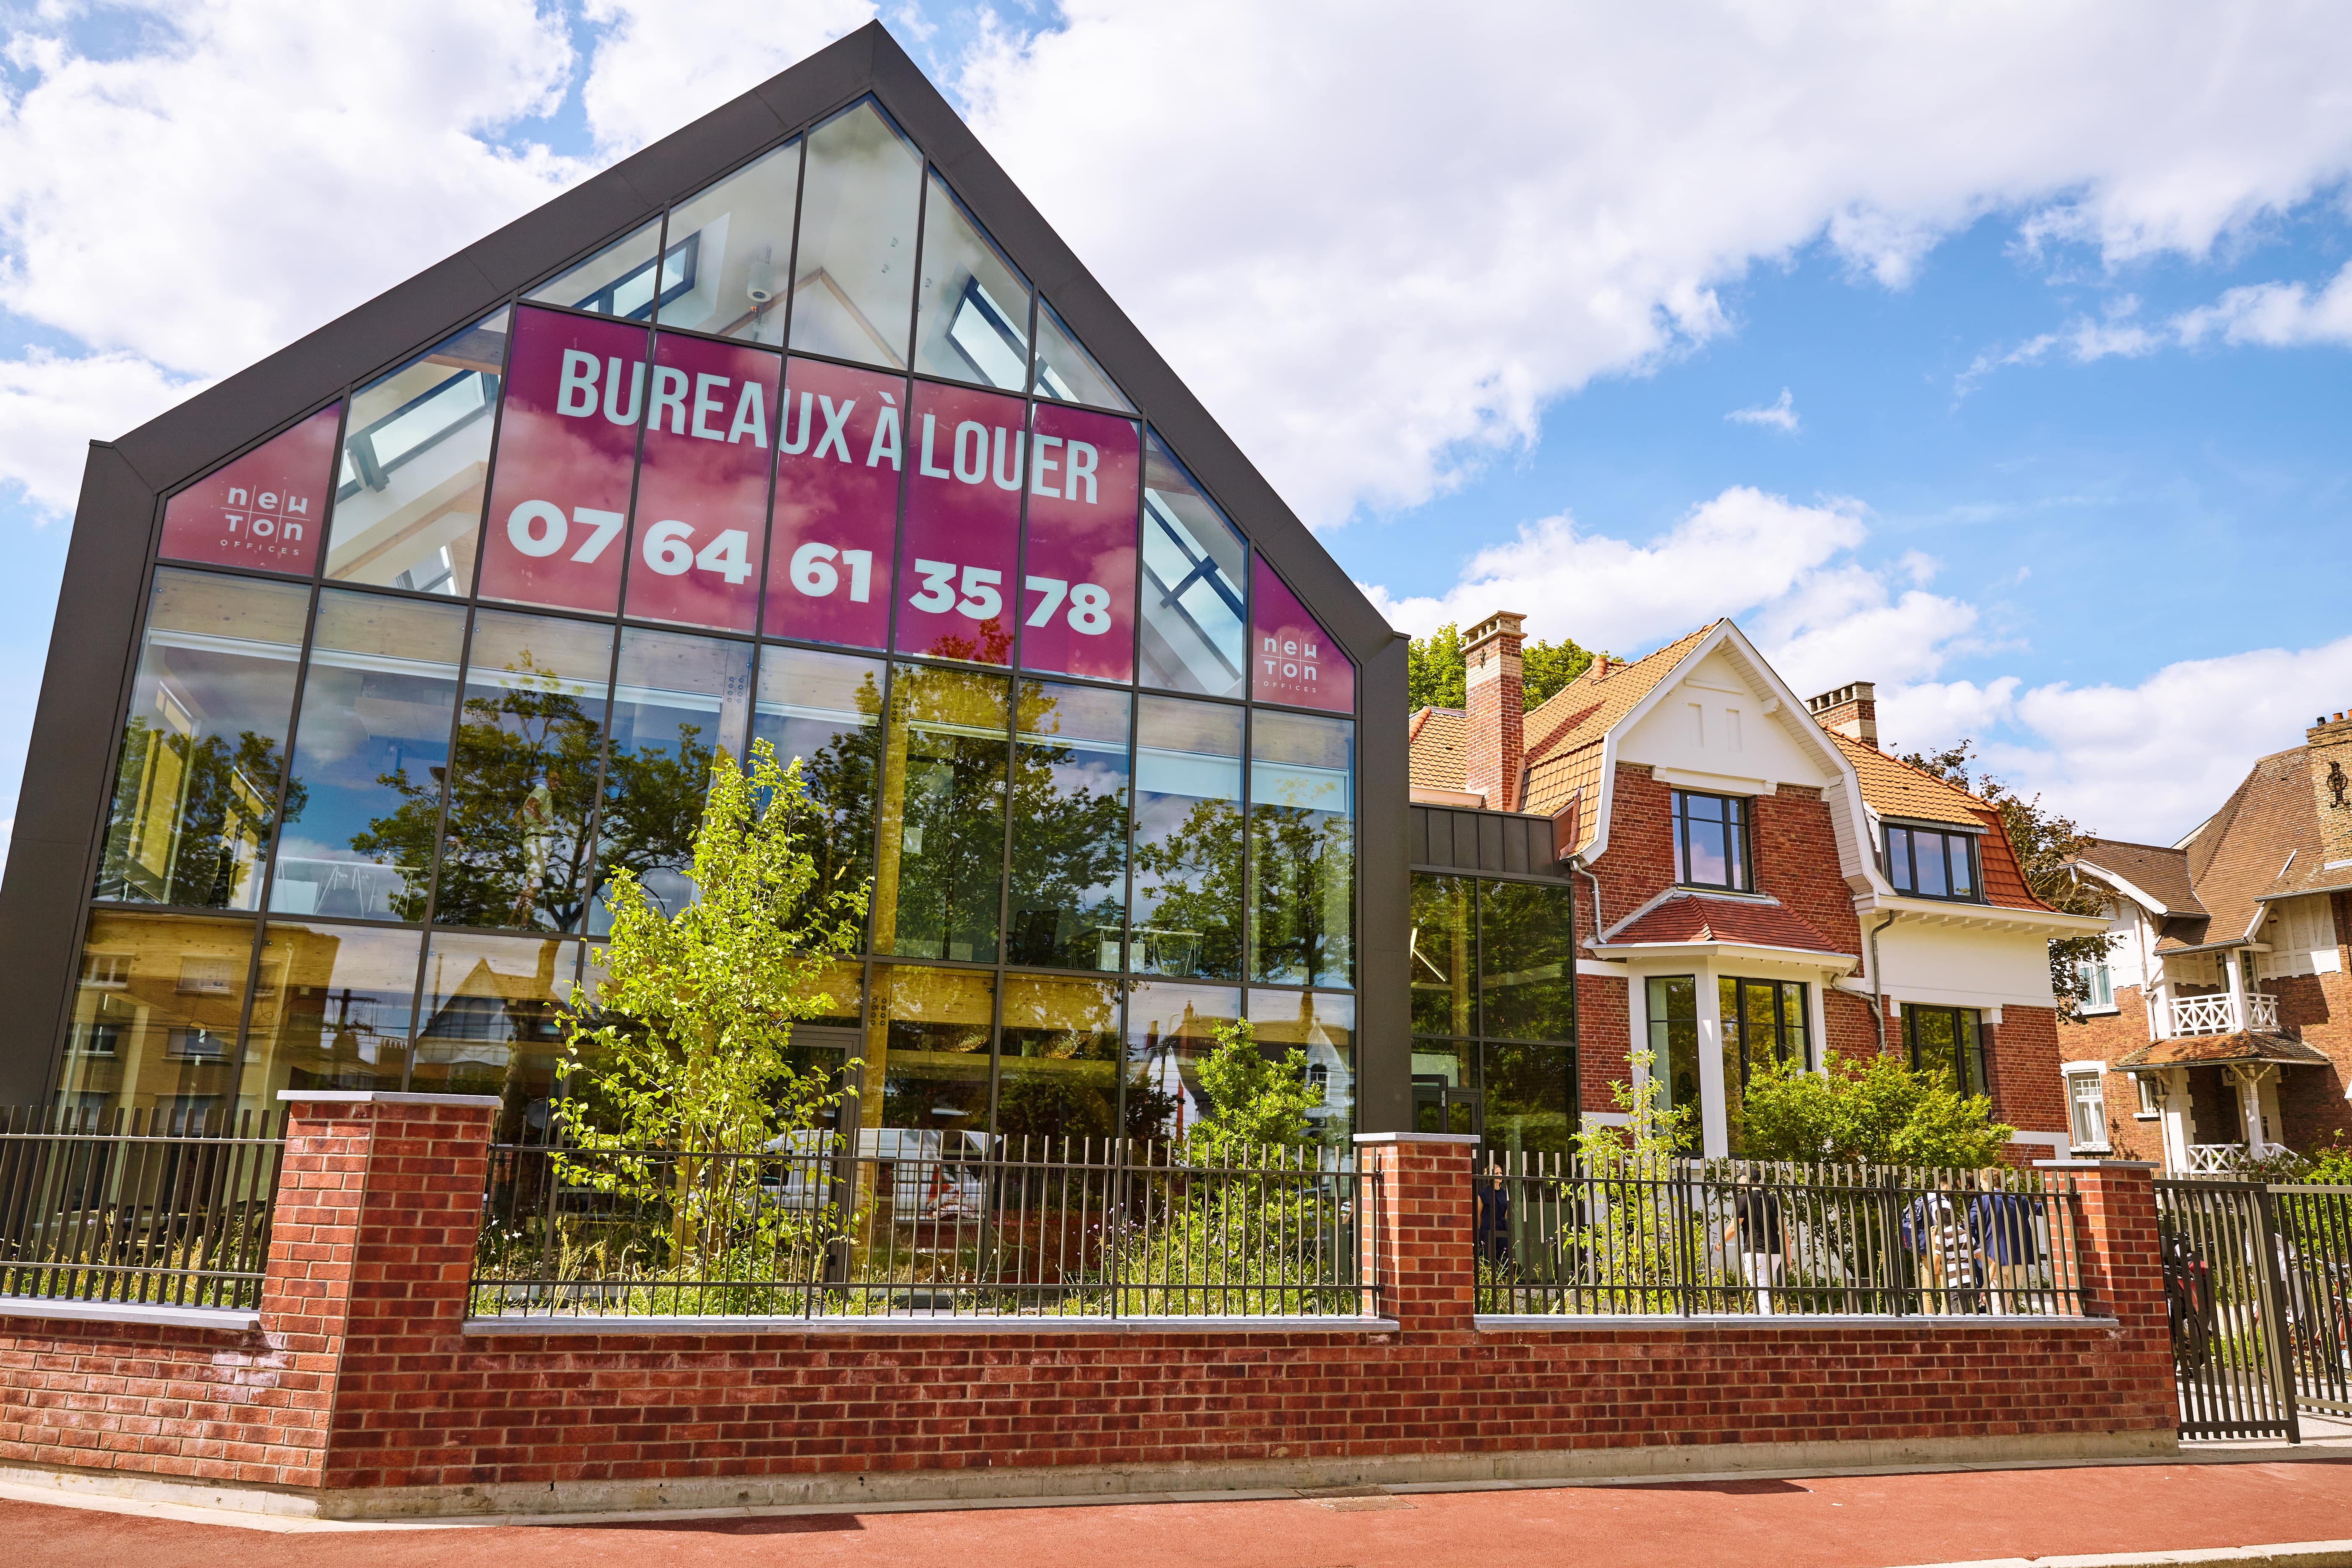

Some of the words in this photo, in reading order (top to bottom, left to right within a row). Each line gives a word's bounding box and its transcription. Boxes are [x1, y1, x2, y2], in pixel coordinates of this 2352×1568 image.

[557, 348, 857, 463] BUREAUX
[866, 390, 902, 472] À
[919, 413, 1099, 505] LOUER
[220, 539, 299, 555] OFFICES
[506, 499, 625, 564] 07
[642, 519, 753, 585] 64
[789, 542, 872, 603] 61
[908, 558, 1003, 620] 35
[1025, 575, 1112, 635] 78
[1264, 681, 1316, 693] OFFICES
